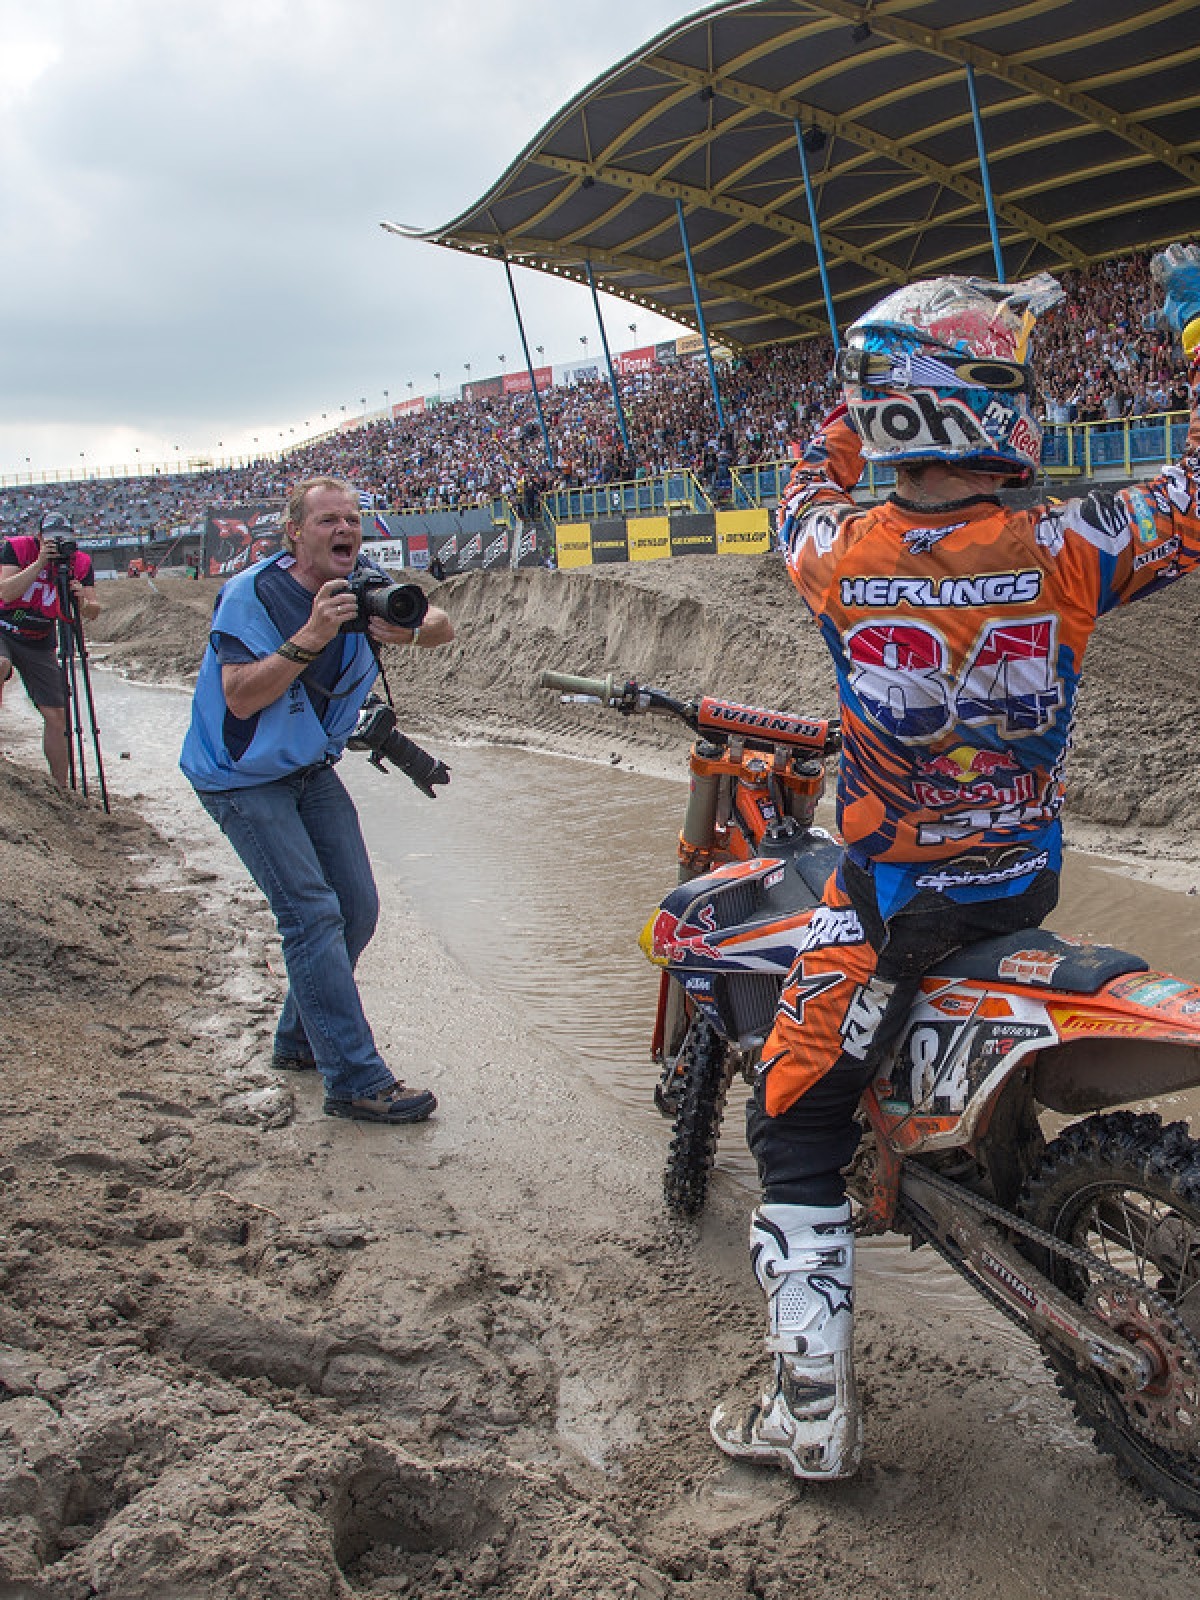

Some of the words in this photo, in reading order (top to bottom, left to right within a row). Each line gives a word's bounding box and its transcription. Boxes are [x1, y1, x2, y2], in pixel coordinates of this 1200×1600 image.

[637, 537, 669, 548] DUNLOP
[725, 531, 767, 543] DUNLOP
[841, 570, 1043, 606] HERLINGS
[844, 615, 1062, 745] 84
[709, 706, 822, 738] RENTHAL
[841, 977, 897, 1060] KTM
[911, 1024, 979, 1112] 84
